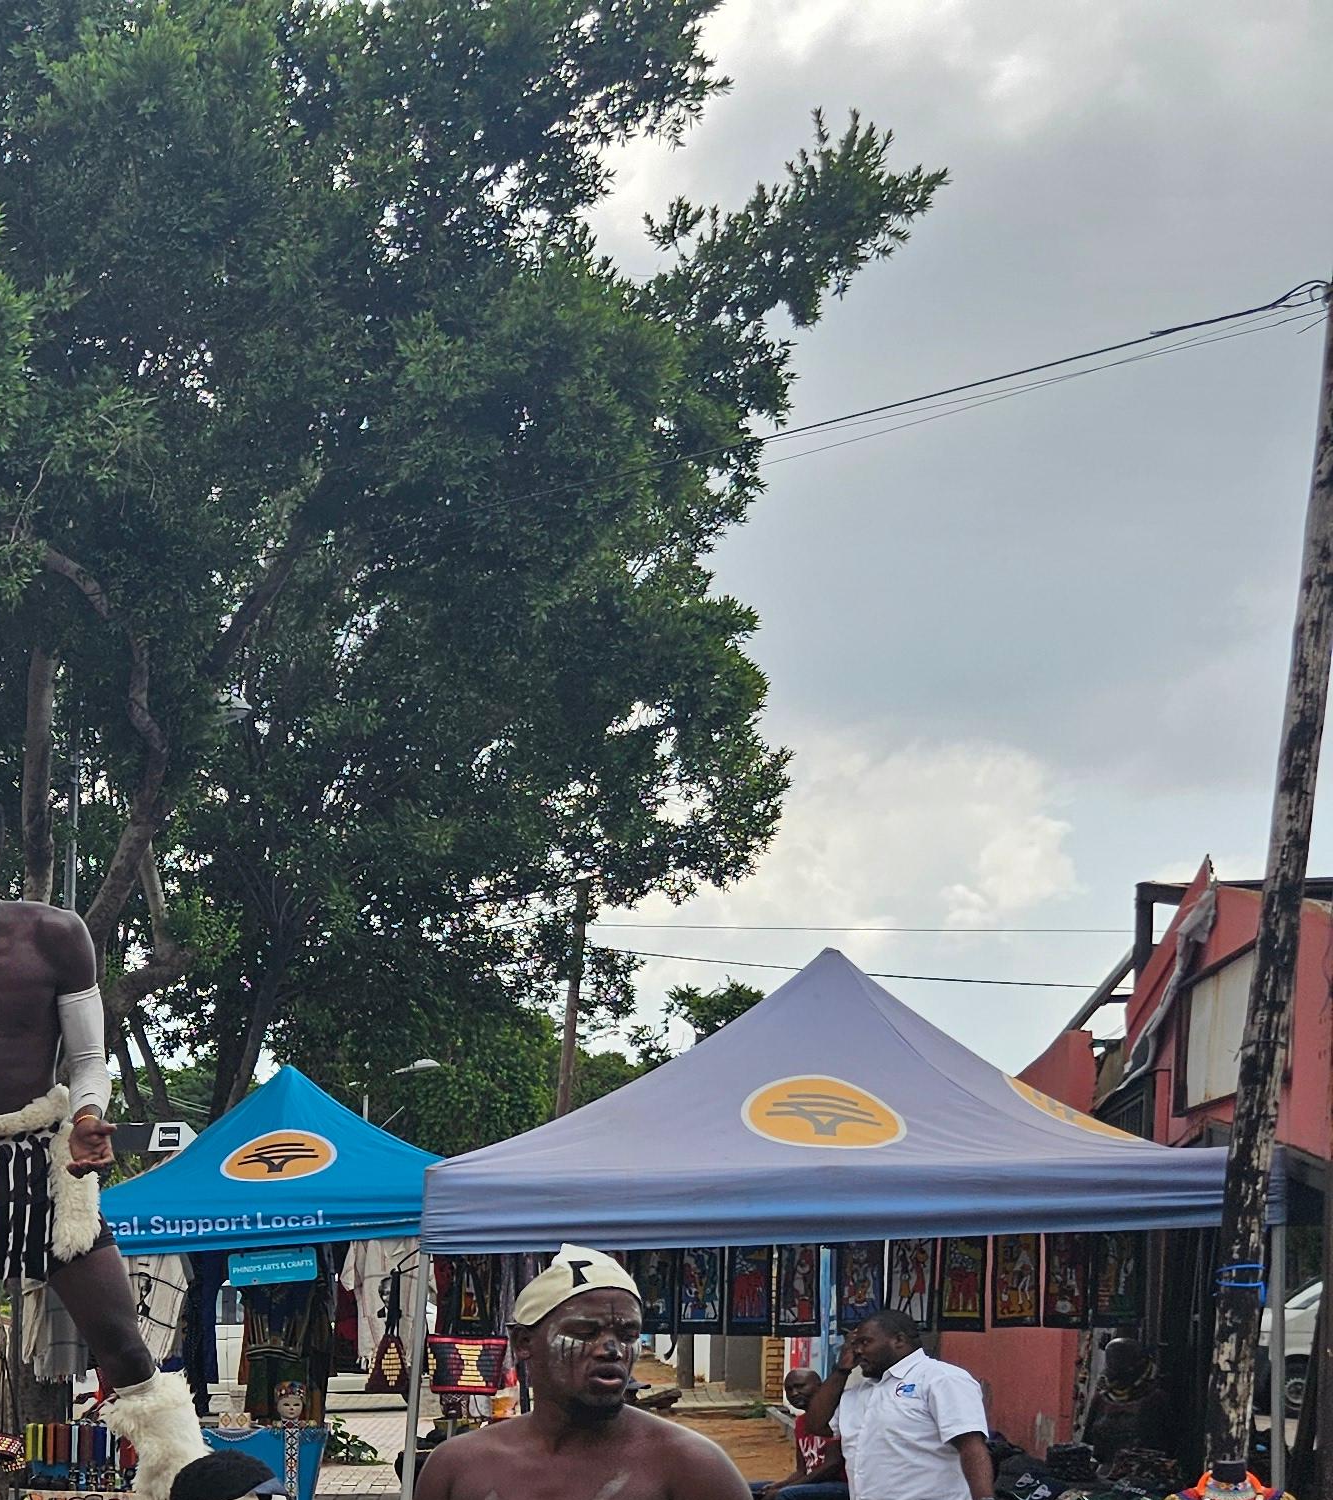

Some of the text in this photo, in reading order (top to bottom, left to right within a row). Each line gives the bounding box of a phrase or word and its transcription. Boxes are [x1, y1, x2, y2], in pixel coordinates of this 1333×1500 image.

[111, 1211, 331, 1237] cal. Support Local.
[263, 1262, 280, 1271] ARTS
[287, 1259, 314, 1269] CRAFTS
